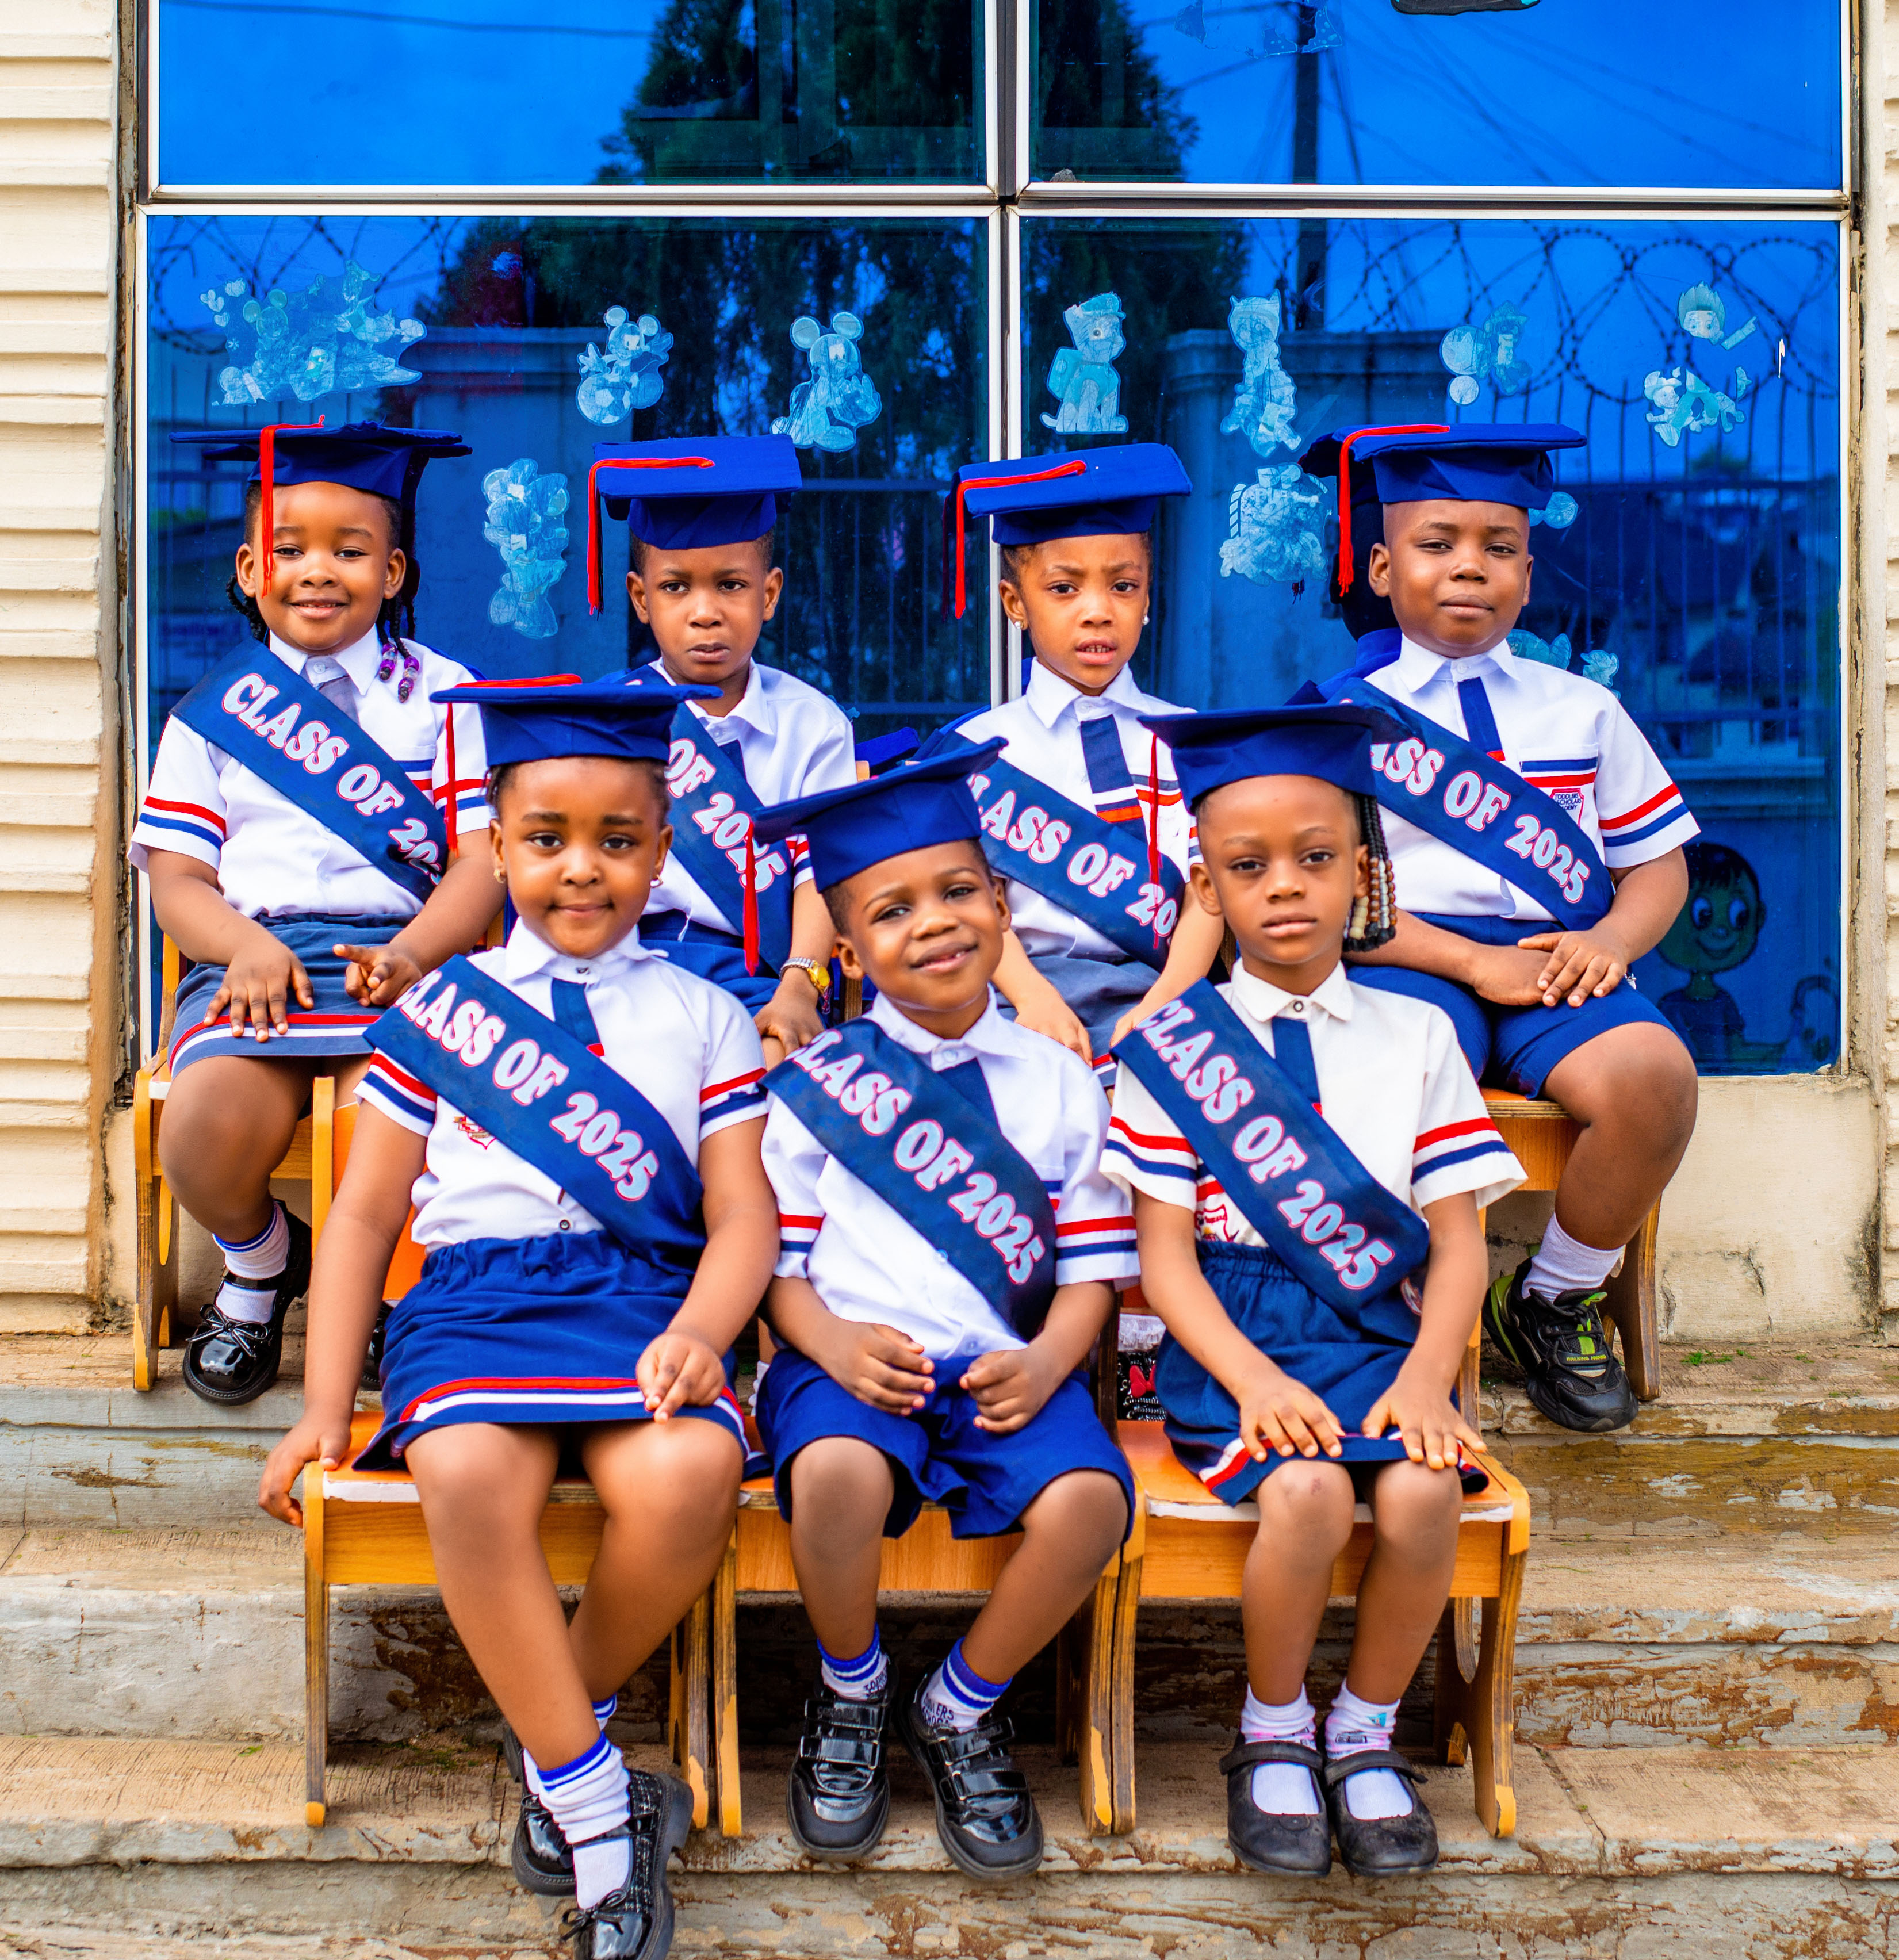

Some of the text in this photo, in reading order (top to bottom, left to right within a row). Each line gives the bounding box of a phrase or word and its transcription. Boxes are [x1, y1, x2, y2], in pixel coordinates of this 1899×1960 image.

[222, 673, 442, 885] CLASS OF 20
[665, 738, 717, 798] OF
[1443, 770, 1511, 832] OF
[1504, 814, 1590, 904] 2025
[966, 774, 1178, 937] ASS OF 20
[492, 1038, 569, 1105] OF
[549, 1092, 660, 1201] 2025
[784, 1029, 1046, 1285] LASS OF 2025
[1232, 1115, 1308, 1184] OF
[1277, 1180, 1395, 1290] 2025
